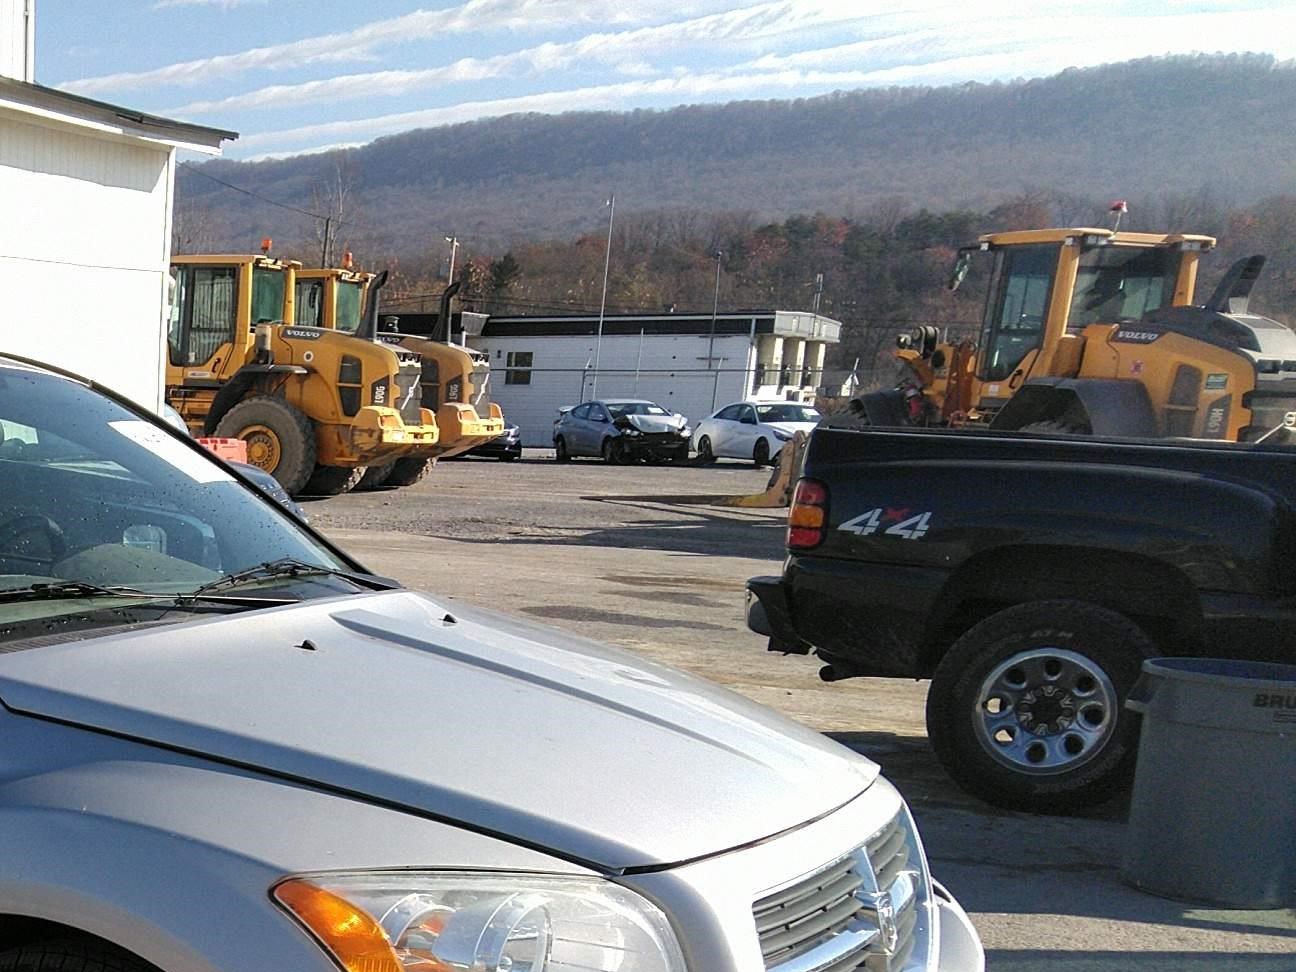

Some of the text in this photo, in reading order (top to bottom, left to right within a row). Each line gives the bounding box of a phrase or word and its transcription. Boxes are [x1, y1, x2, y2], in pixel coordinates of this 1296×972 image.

[286, 329, 320, 338] VOLVO
[1118, 330, 1159, 341] VOLVO
[373, 385, 386, 404] L90G
[1206, 407, 1225, 433] L90H
